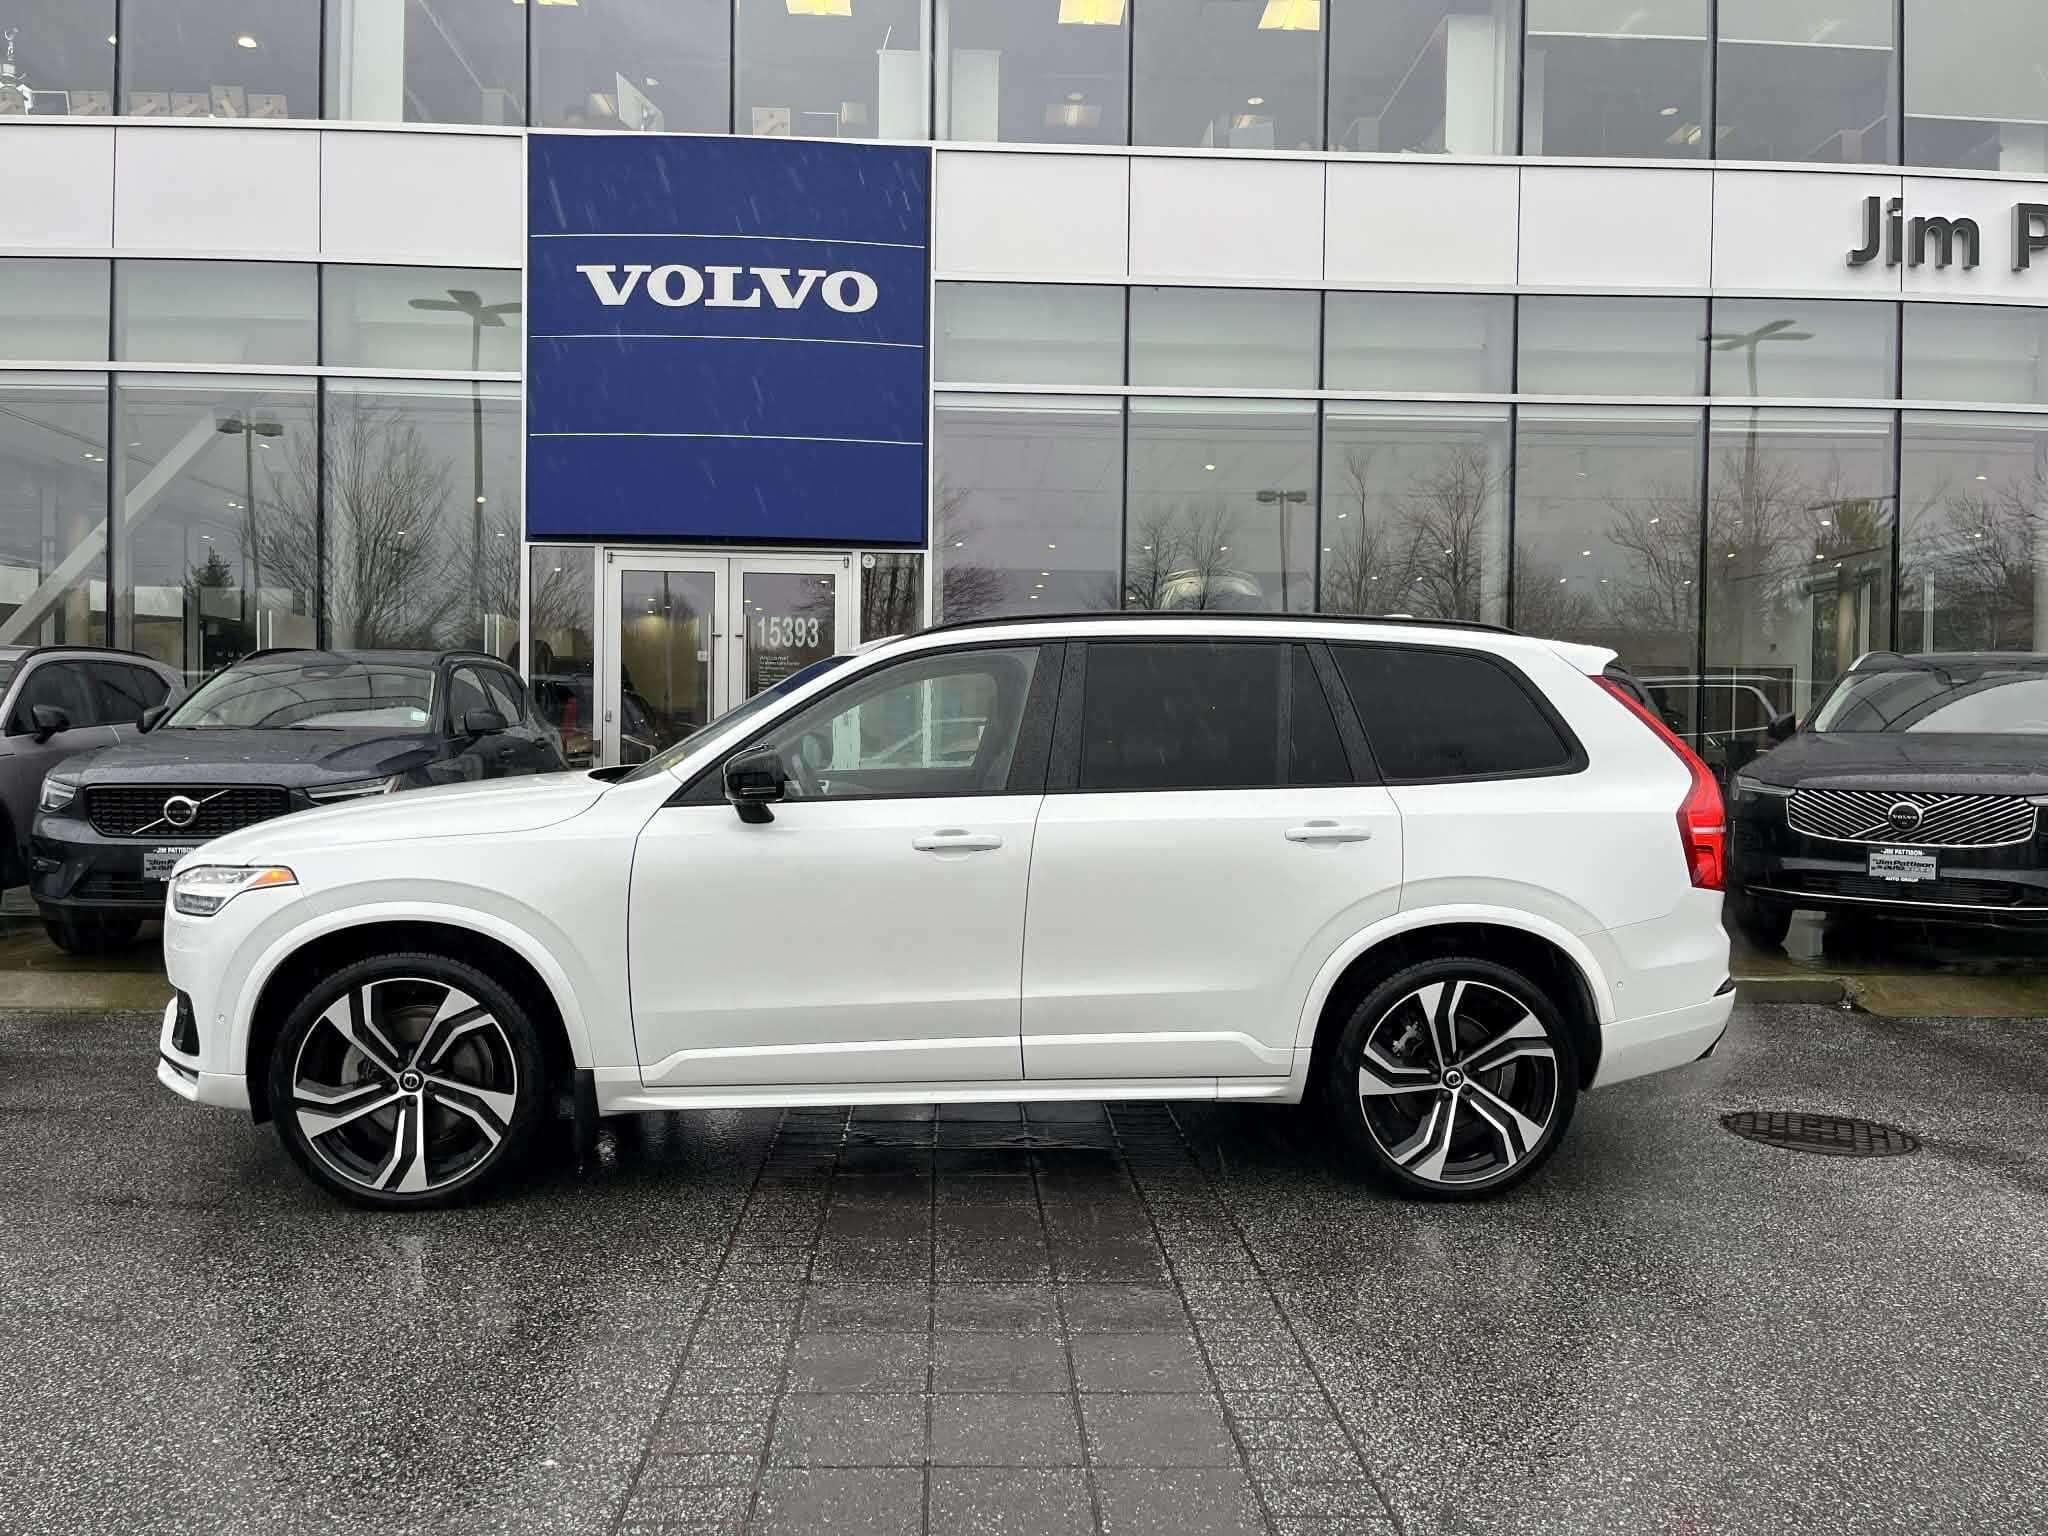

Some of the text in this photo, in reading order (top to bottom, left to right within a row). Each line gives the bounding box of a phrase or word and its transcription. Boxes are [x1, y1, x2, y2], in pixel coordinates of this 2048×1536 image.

[1847, 196, 1980, 269] Jim
[576, 264, 878, 313] VOLVO
[758, 616, 819, 648] 15393
